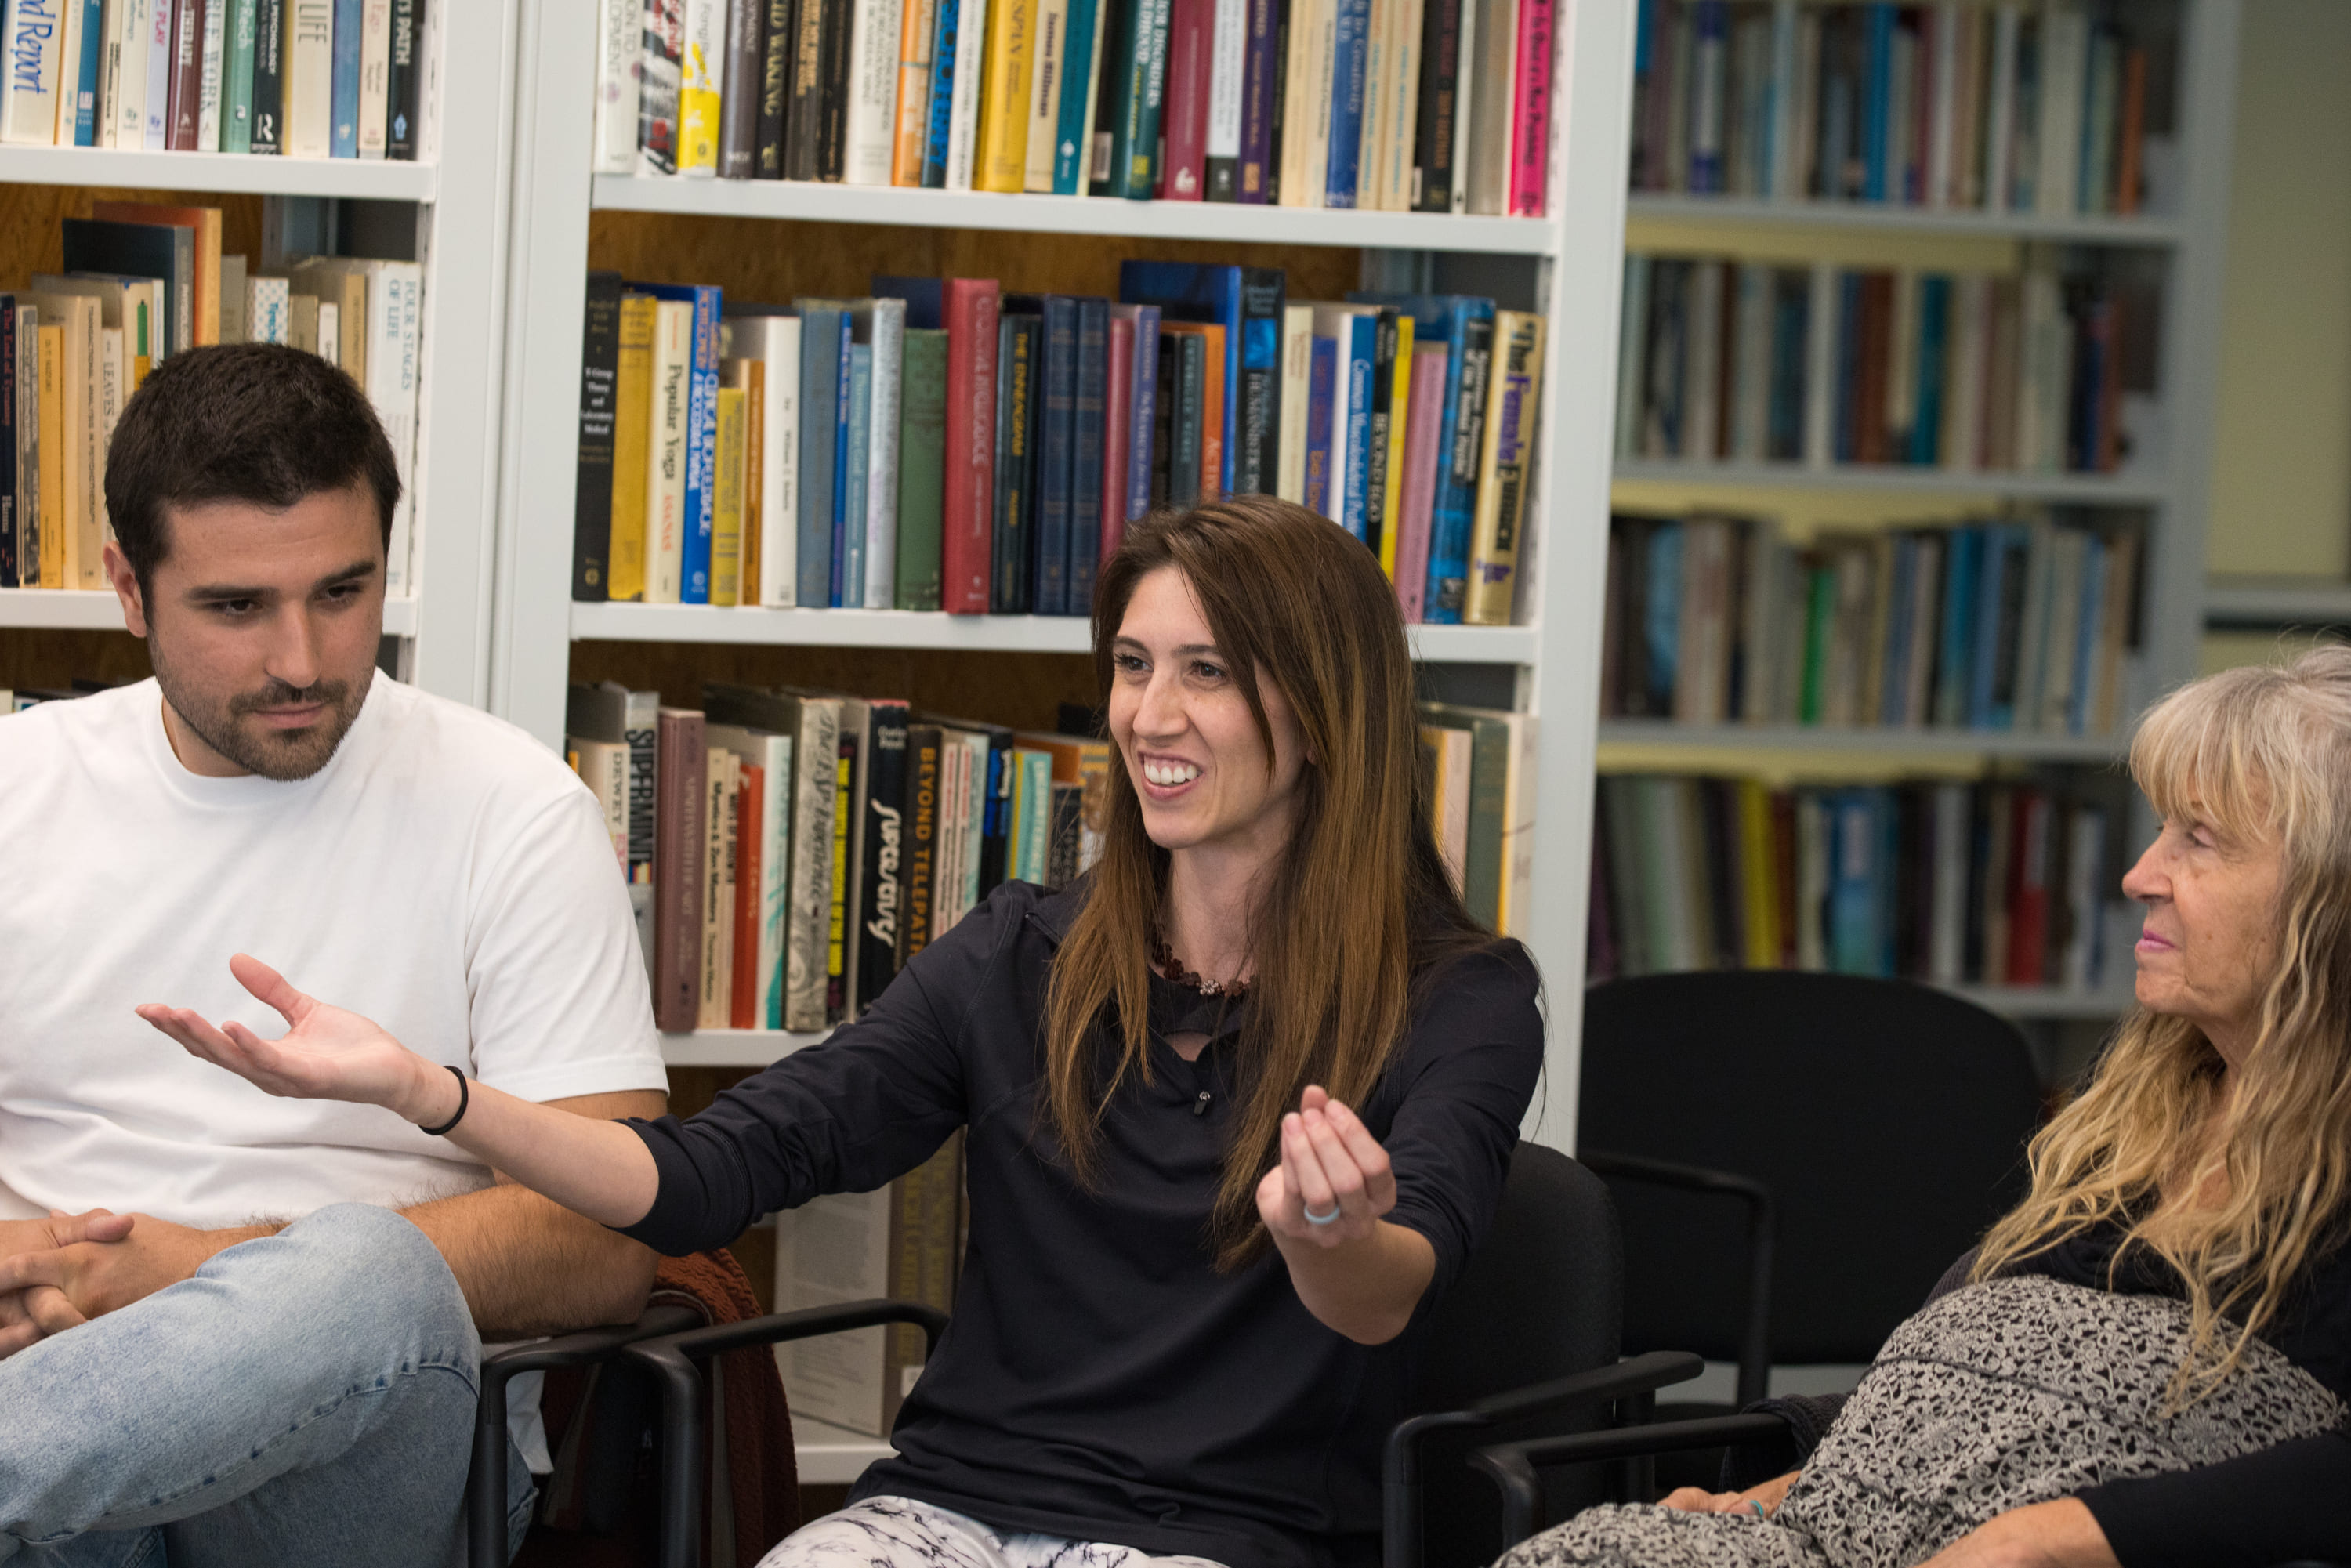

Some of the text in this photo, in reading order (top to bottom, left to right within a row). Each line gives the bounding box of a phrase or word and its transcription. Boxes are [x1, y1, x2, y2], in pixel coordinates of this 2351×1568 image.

[155, 11, 167, 47] PLAY
[298, 5, 328, 45] LIFE
[395, 17, 411, 67] PATH
[9, 22, 53, 95] Report
[1146, 29, 1167, 109] DISORDERS
[86, 305, 96, 380] TRANSACTIONAL
[386, 280, 400, 339] OF LIFE
[400, 280, 417, 390] FOUR STAGES
[103, 361, 114, 416] LEAVES
[663, 364, 683, 430] Popular
[1012, 332, 1028, 458] THE ENNEAGRAM
[1498, 373, 1532, 462] Female
[88, 433, 95, 444] IN
[661, 438, 681, 480] Yoga
[1310, 450, 1325, 476] be
[1367, 412, 1389, 523] BEYOND EGO
[87, 445, 96, 524] PSYCHOTHERAPY
[612, 751, 623, 826] DEWEY
[625, 728, 656, 865] SUPERMIND
[710, 781, 723, 830] Mystics
[915, 746, 937, 842] BEYOND
[708, 846, 721, 868] Zen
[708, 871, 720, 924] Masters
